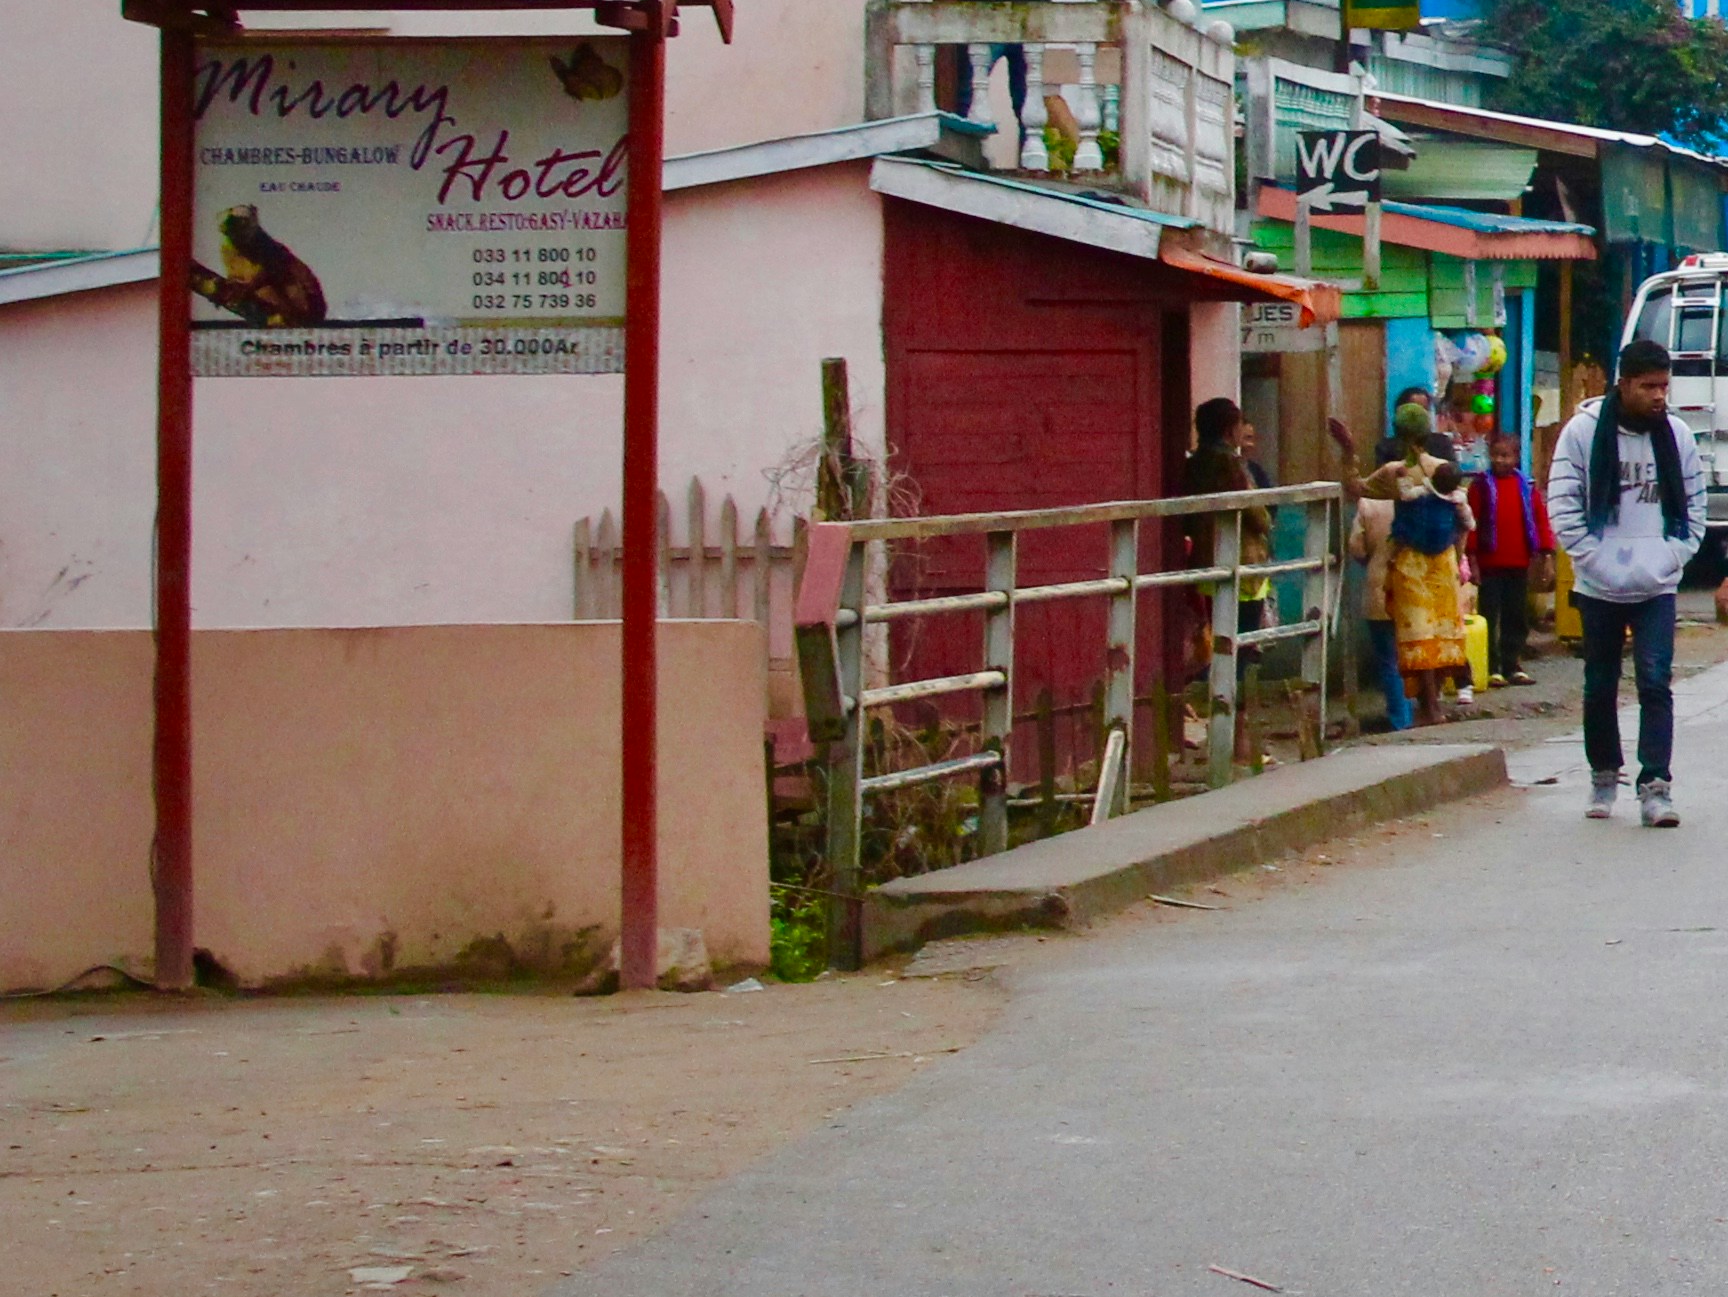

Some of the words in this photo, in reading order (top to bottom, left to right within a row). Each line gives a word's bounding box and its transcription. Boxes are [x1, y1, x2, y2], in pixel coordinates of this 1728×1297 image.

[194, 53, 456, 171] Mirary
[200, 145, 400, 166] CHAMBRES-BUNGALOW
[436, 126, 630, 205] Hotel
[1296, 132, 1380, 182] WC
[259, 181, 285, 193] EAU
[289, 180, 342, 192] CHAUDE
[472, 248, 506, 263] 033
[511, 248, 531, 263] 11
[575, 247, 597, 262] 10
[472, 271, 506, 286] 034
[511, 271, 531, 286] 11
[575, 271, 597, 286] 10
[472, 294, 506, 309] 032
[512, 294, 533, 309] 75
[538, 294, 570, 309] 739
[575, 294, 597, 309] 36
[240, 337, 352, 355] Chambres
[358, 337, 376, 355] à
[378, 338, 441, 359] partir
[446, 337, 473, 355] de
